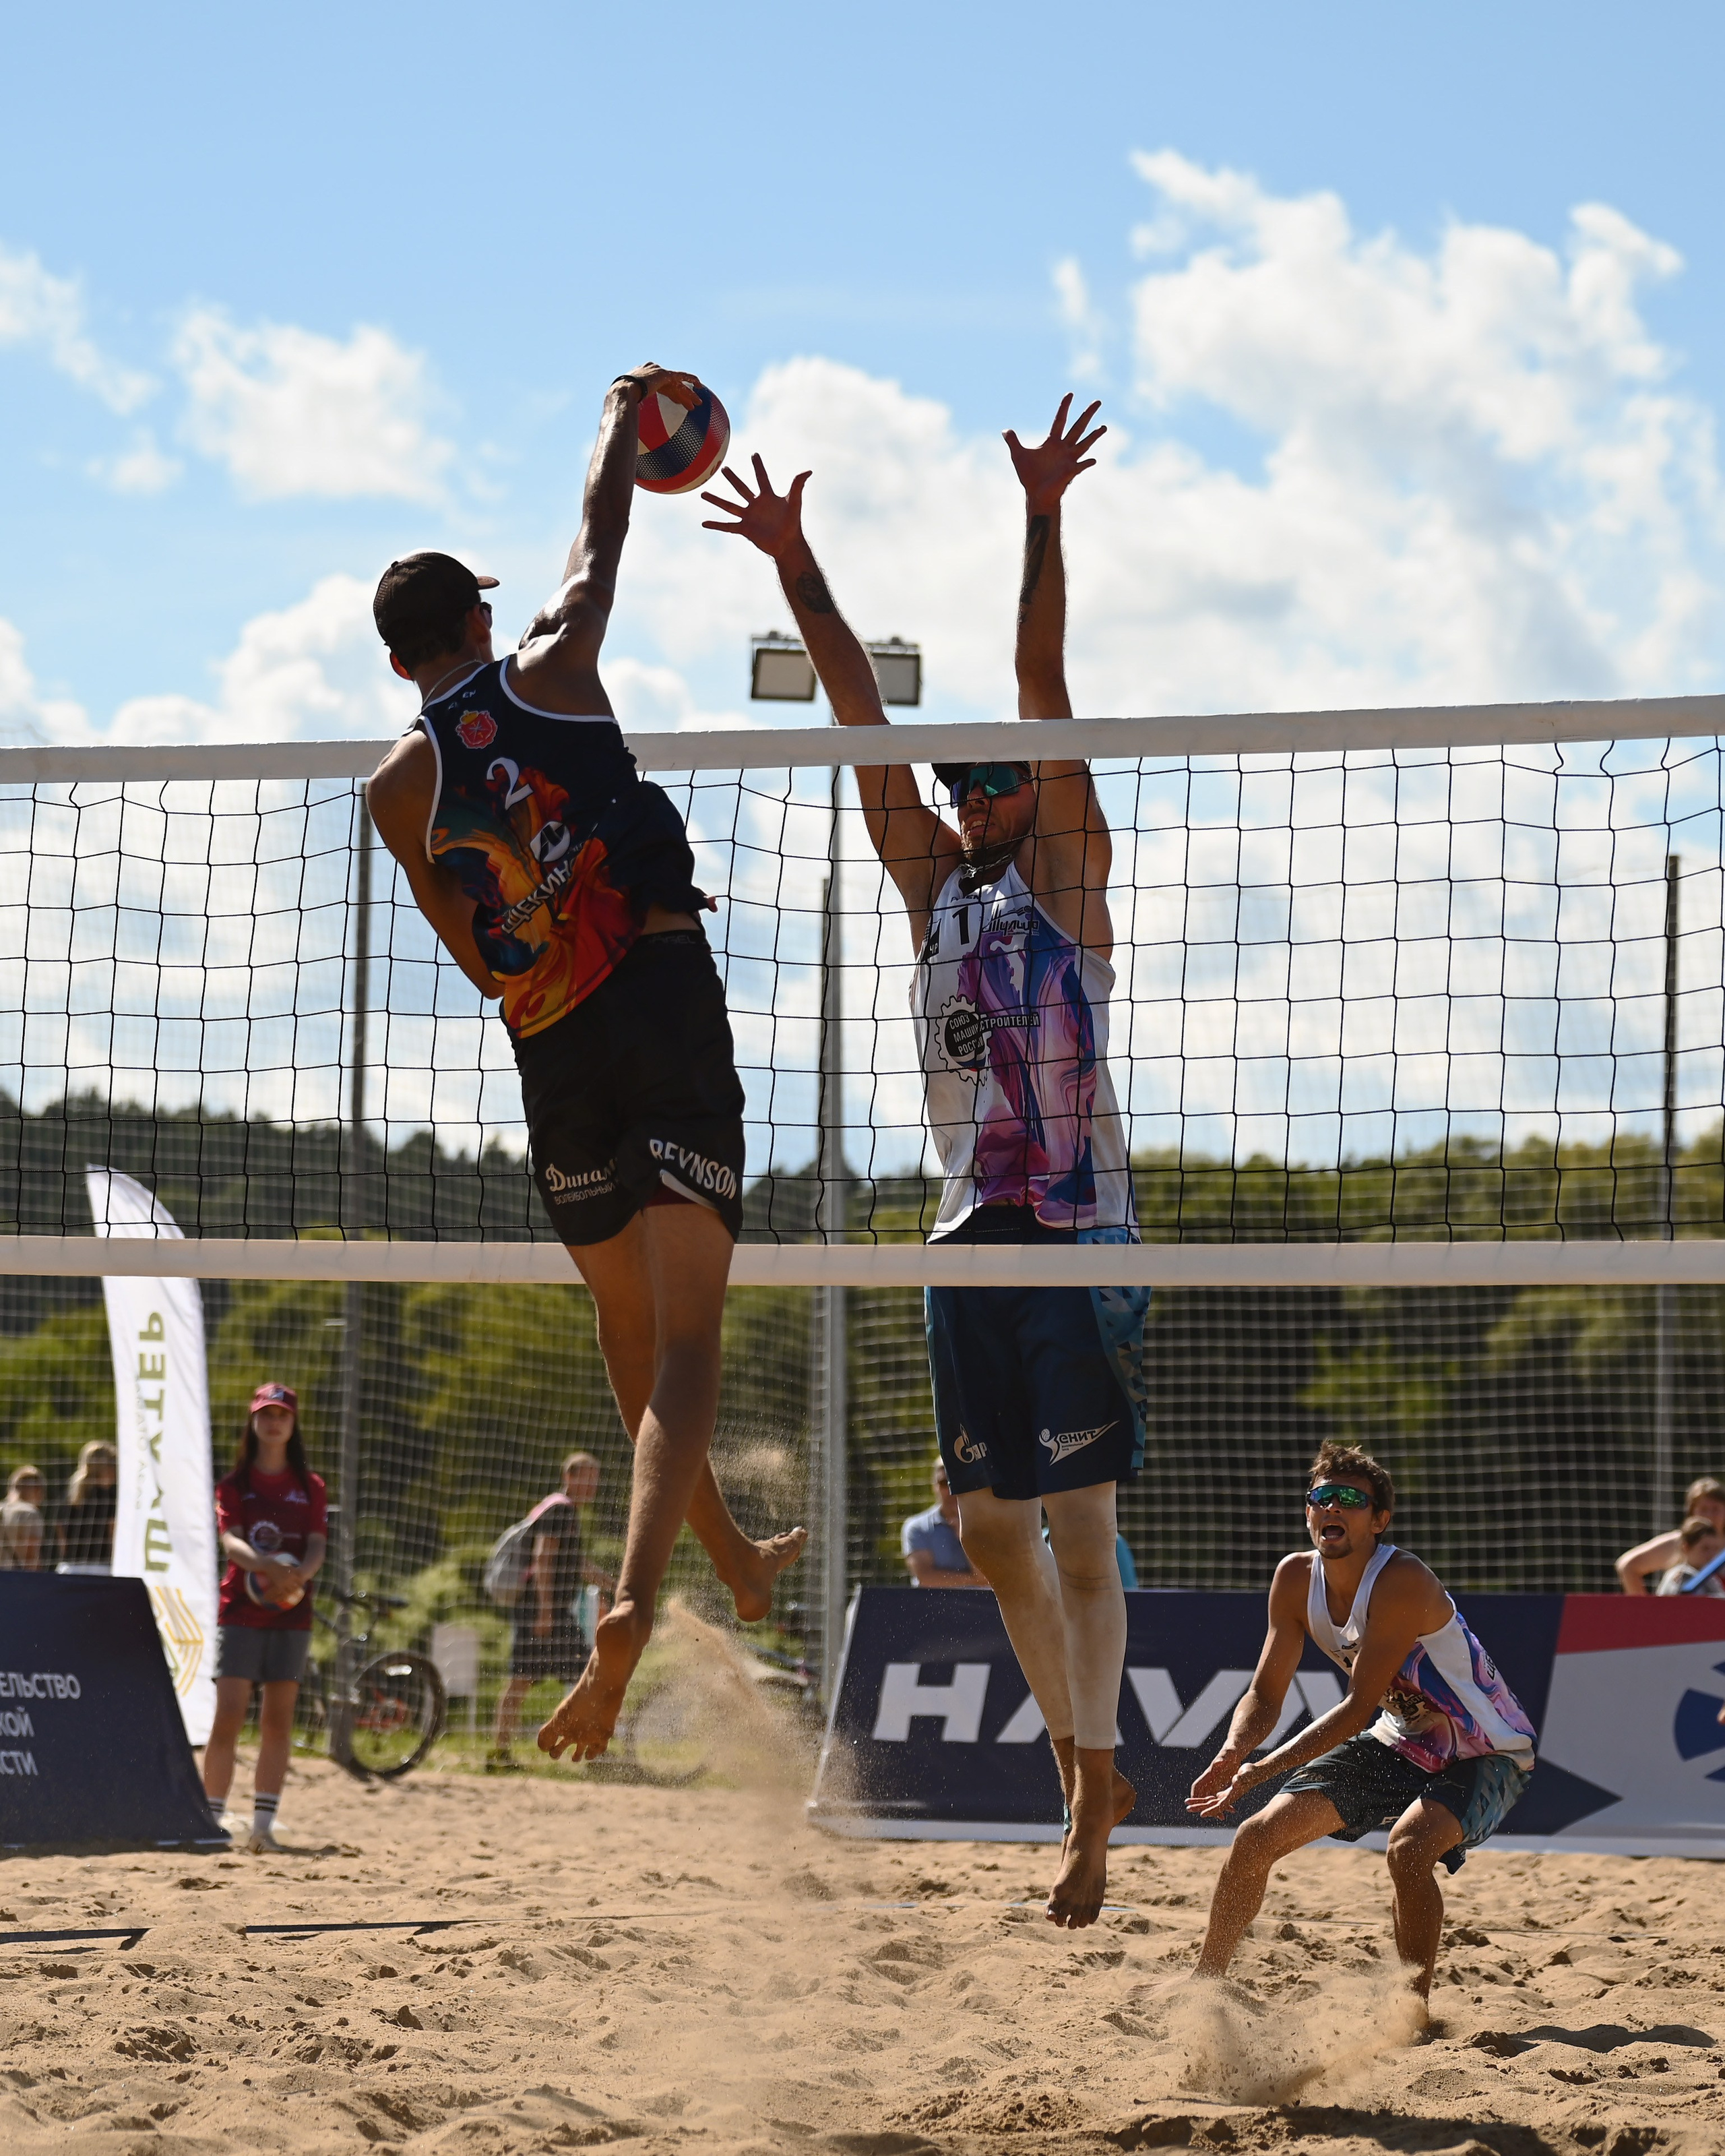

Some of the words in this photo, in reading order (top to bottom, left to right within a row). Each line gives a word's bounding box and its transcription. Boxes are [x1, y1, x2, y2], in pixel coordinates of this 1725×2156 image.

[487, 757, 534, 810] 2
[501, 857, 578, 934] ЩЕКИН
[952, 906, 970, 945] 1
[949, 1014, 970, 1030] СОЮЗ
[953, 1014, 1039, 1043] МАШИНСТРОИТЕЛЙ
